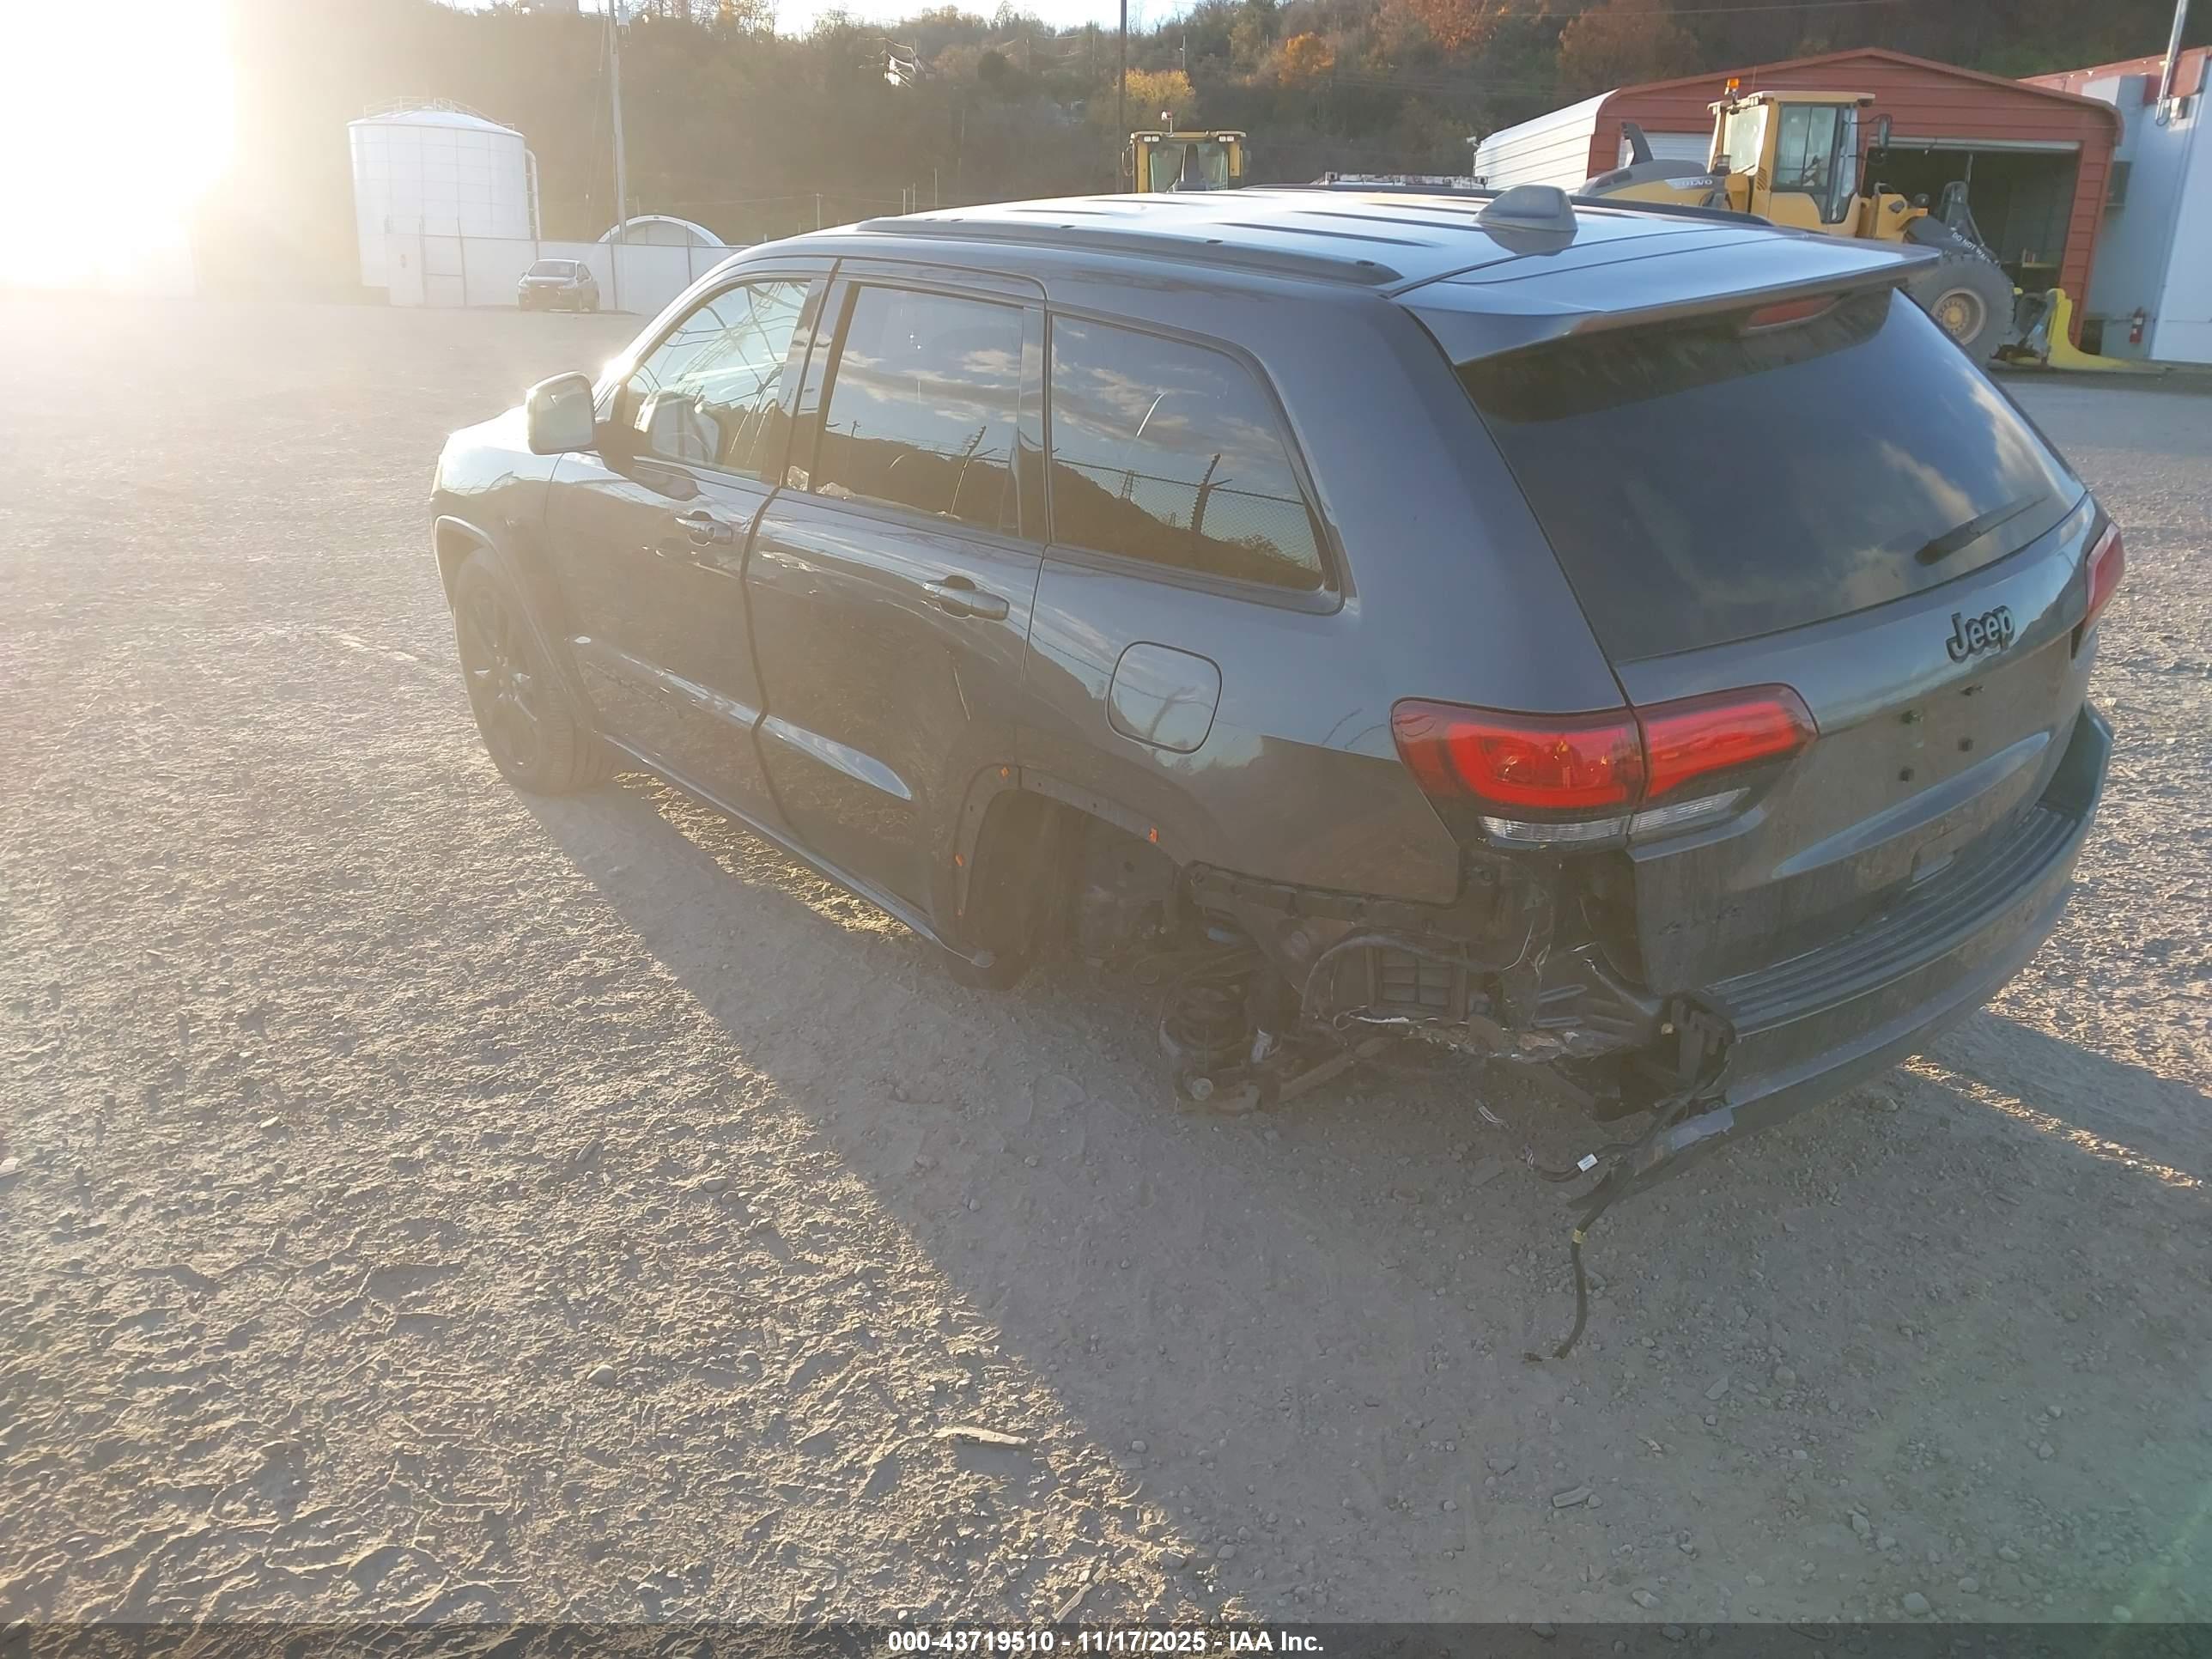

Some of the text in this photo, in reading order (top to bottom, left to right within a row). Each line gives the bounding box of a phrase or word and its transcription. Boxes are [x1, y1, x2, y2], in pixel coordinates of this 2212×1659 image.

[1952, 232, 1963, 241] DO
[1962, 239, 1977, 251] NOT
[1946, 605, 2015, 663] Jeep
